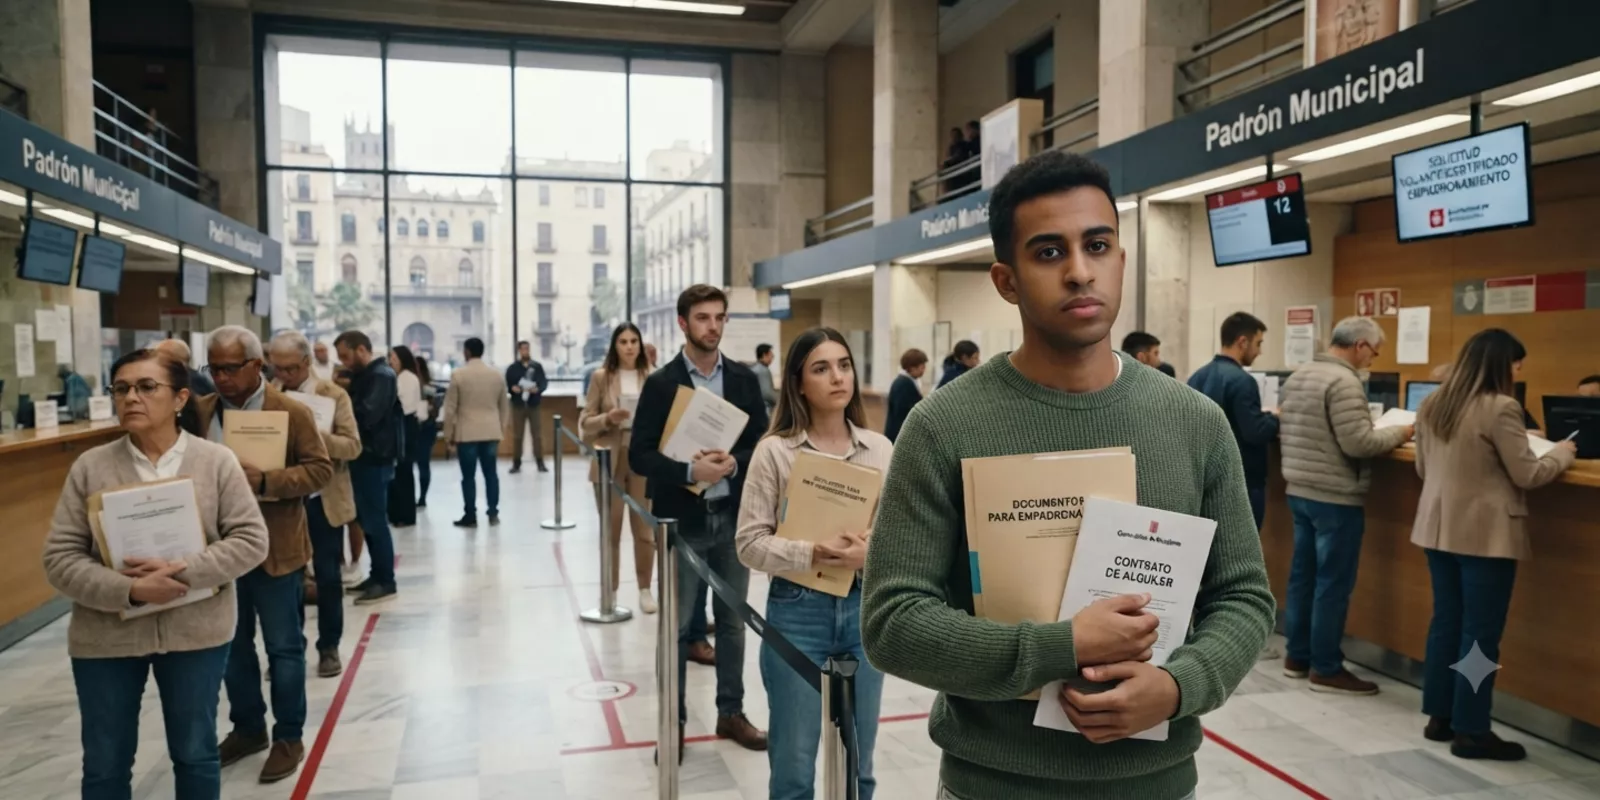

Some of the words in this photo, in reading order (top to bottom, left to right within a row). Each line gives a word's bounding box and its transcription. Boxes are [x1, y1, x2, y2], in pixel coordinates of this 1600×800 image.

[1206, 104, 1283, 151] Padrón
[1289, 48, 1424, 124] Municipal
[22, 137, 80, 188] Padrón
[82, 164, 140, 212] Municipal
[1273, 196, 1291, 214] 12
[988, 512, 1016, 522] PARA
[1105, 567, 1121, 579] DE
